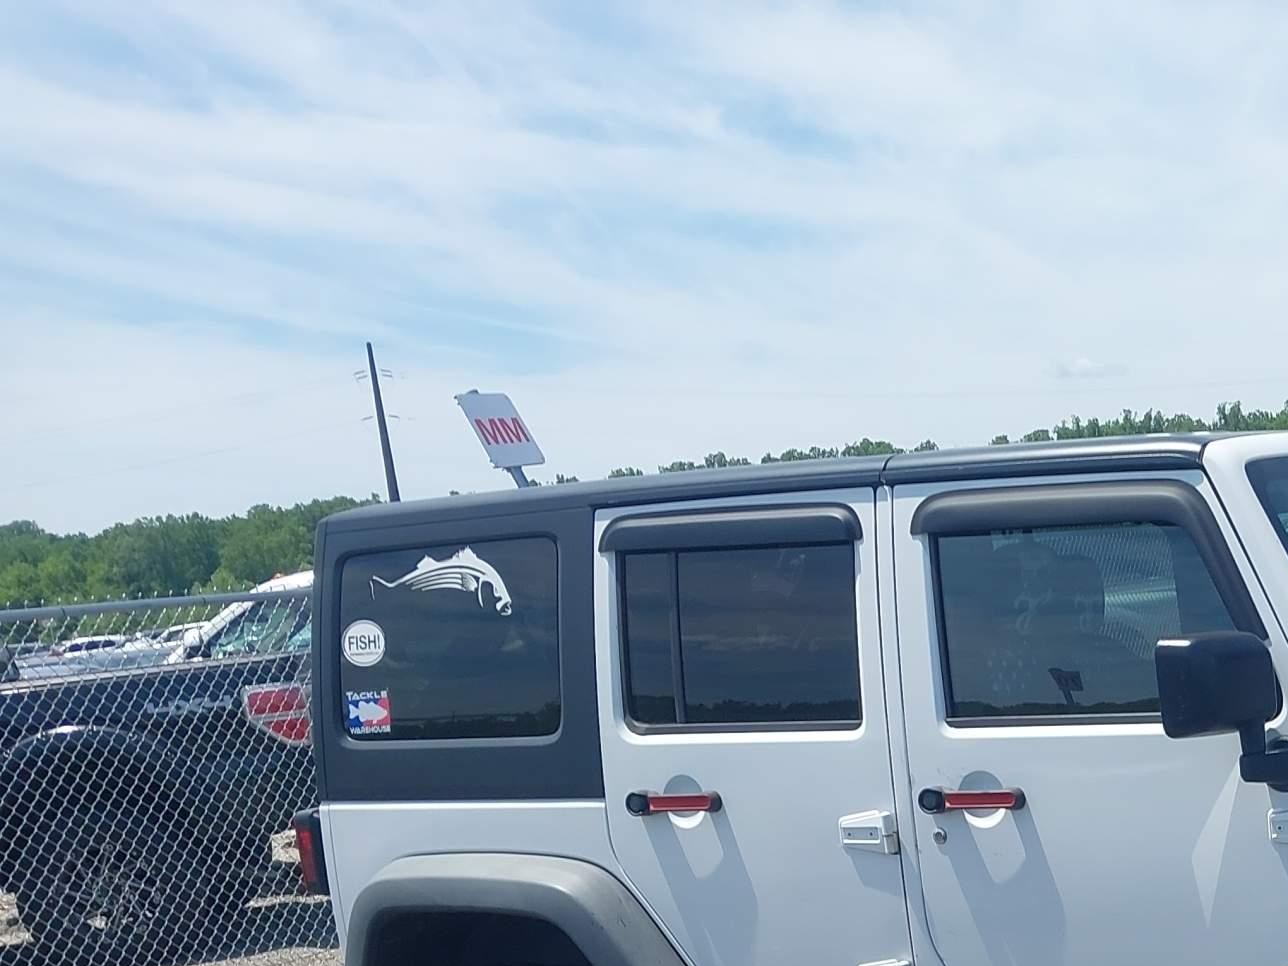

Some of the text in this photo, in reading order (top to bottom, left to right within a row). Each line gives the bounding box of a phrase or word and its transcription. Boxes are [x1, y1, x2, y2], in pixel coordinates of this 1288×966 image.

[474, 417, 530, 446] MM
[347, 633, 381, 652] FISH!
[345, 690, 388, 701] TACKLE
[349, 723, 391, 735] WAREHOUSE
